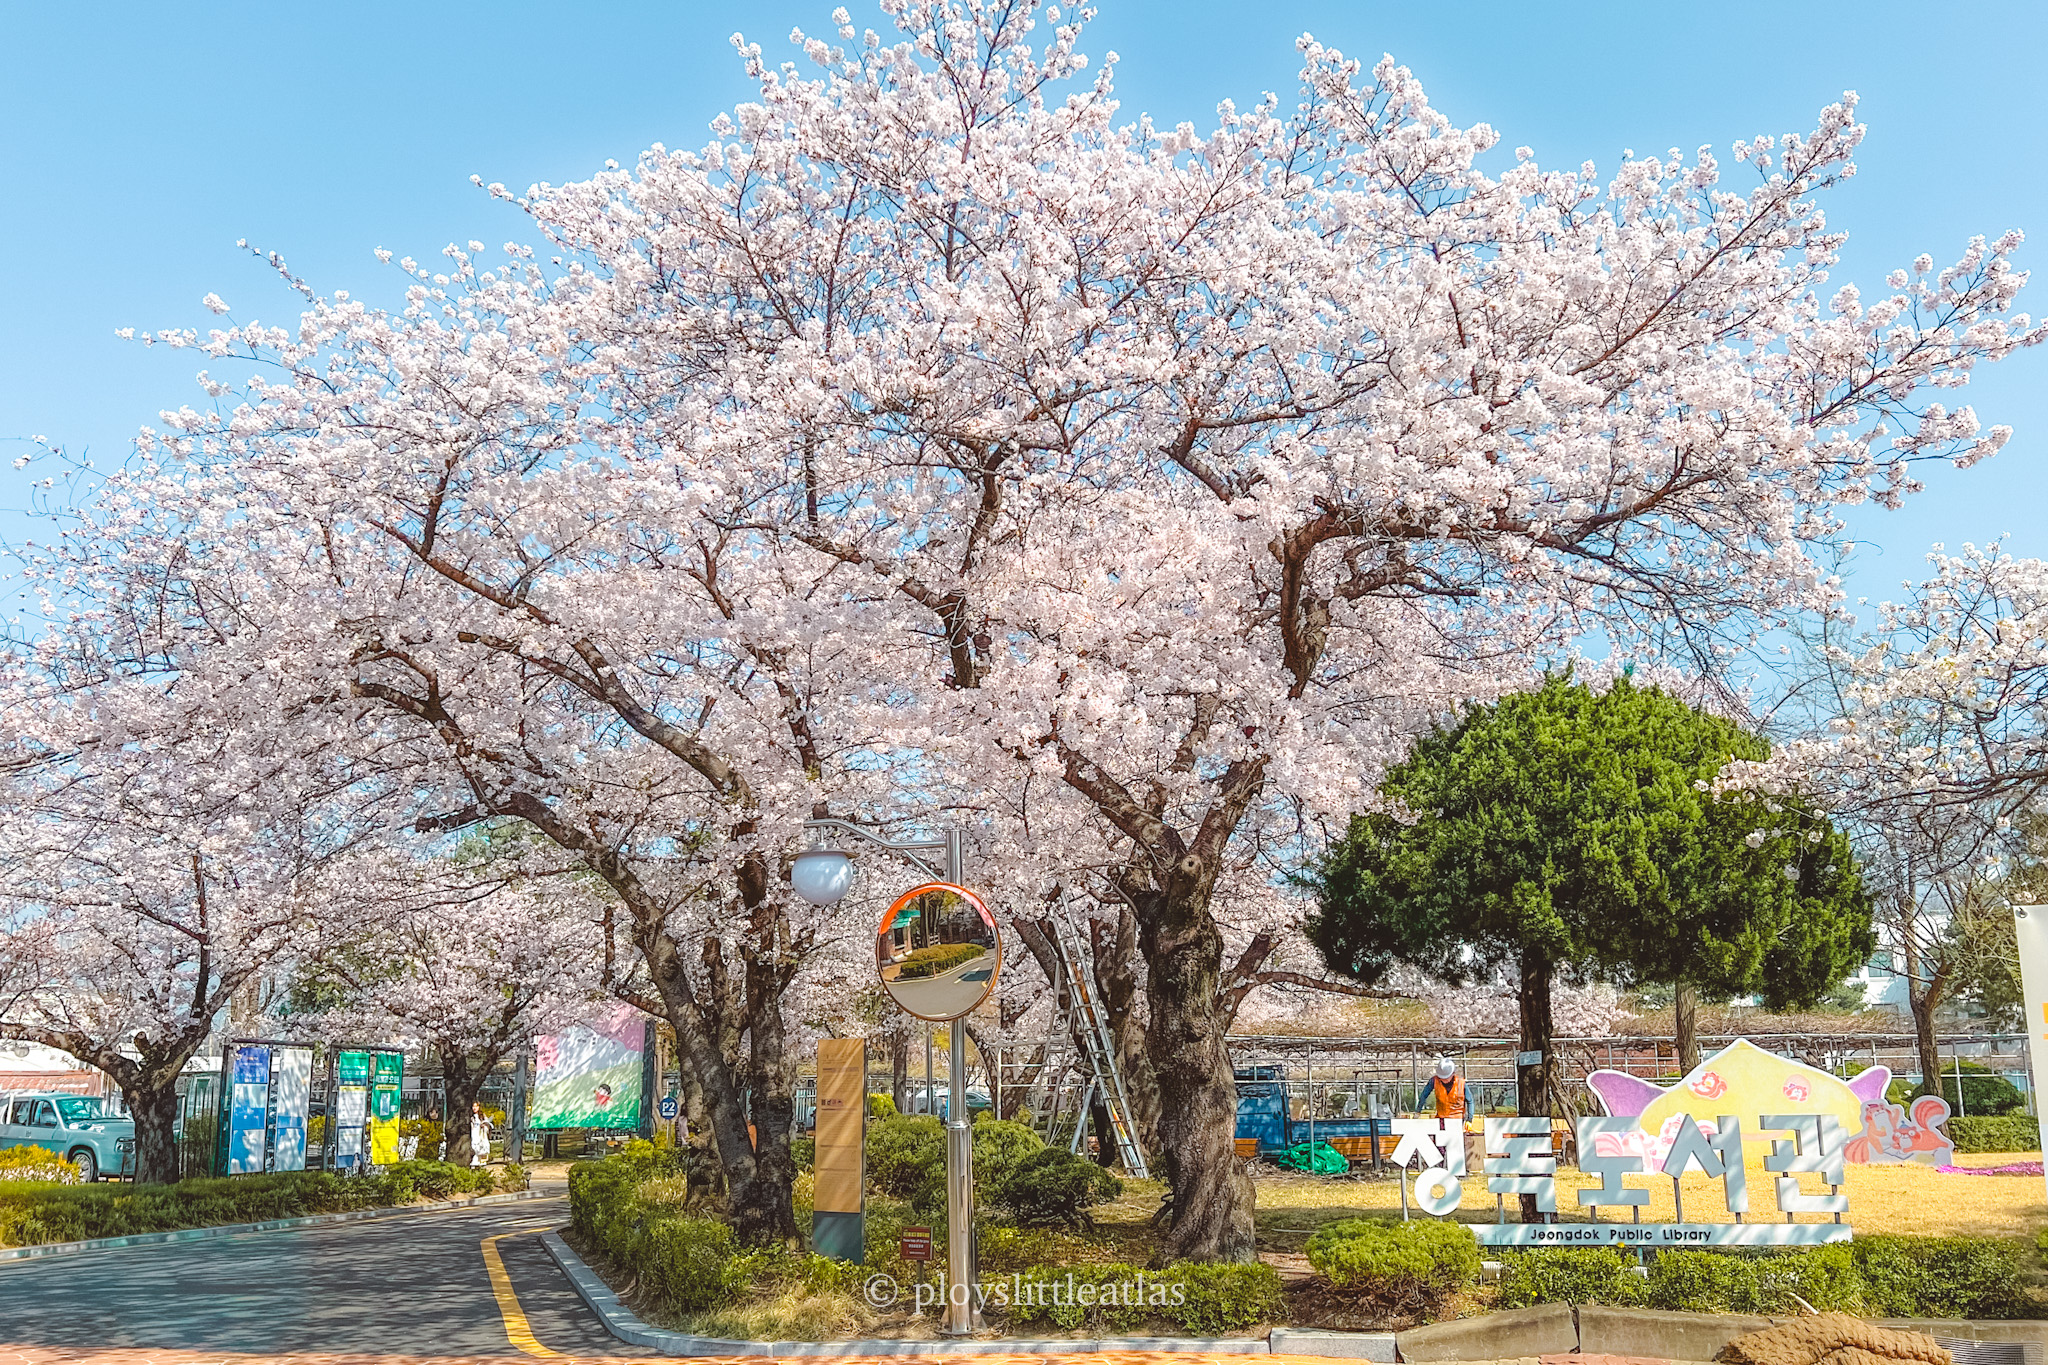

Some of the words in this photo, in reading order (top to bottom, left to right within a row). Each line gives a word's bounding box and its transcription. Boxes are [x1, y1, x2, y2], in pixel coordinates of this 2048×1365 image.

[662, 1102, 675, 1111] P2
[1390, 1114, 1849, 1216] 정독도서관
[1531, 1229, 1600, 1241] Jeongdok
[1610, 1229, 1653, 1240] Public
[1663, 1229, 1711, 1241] Library
